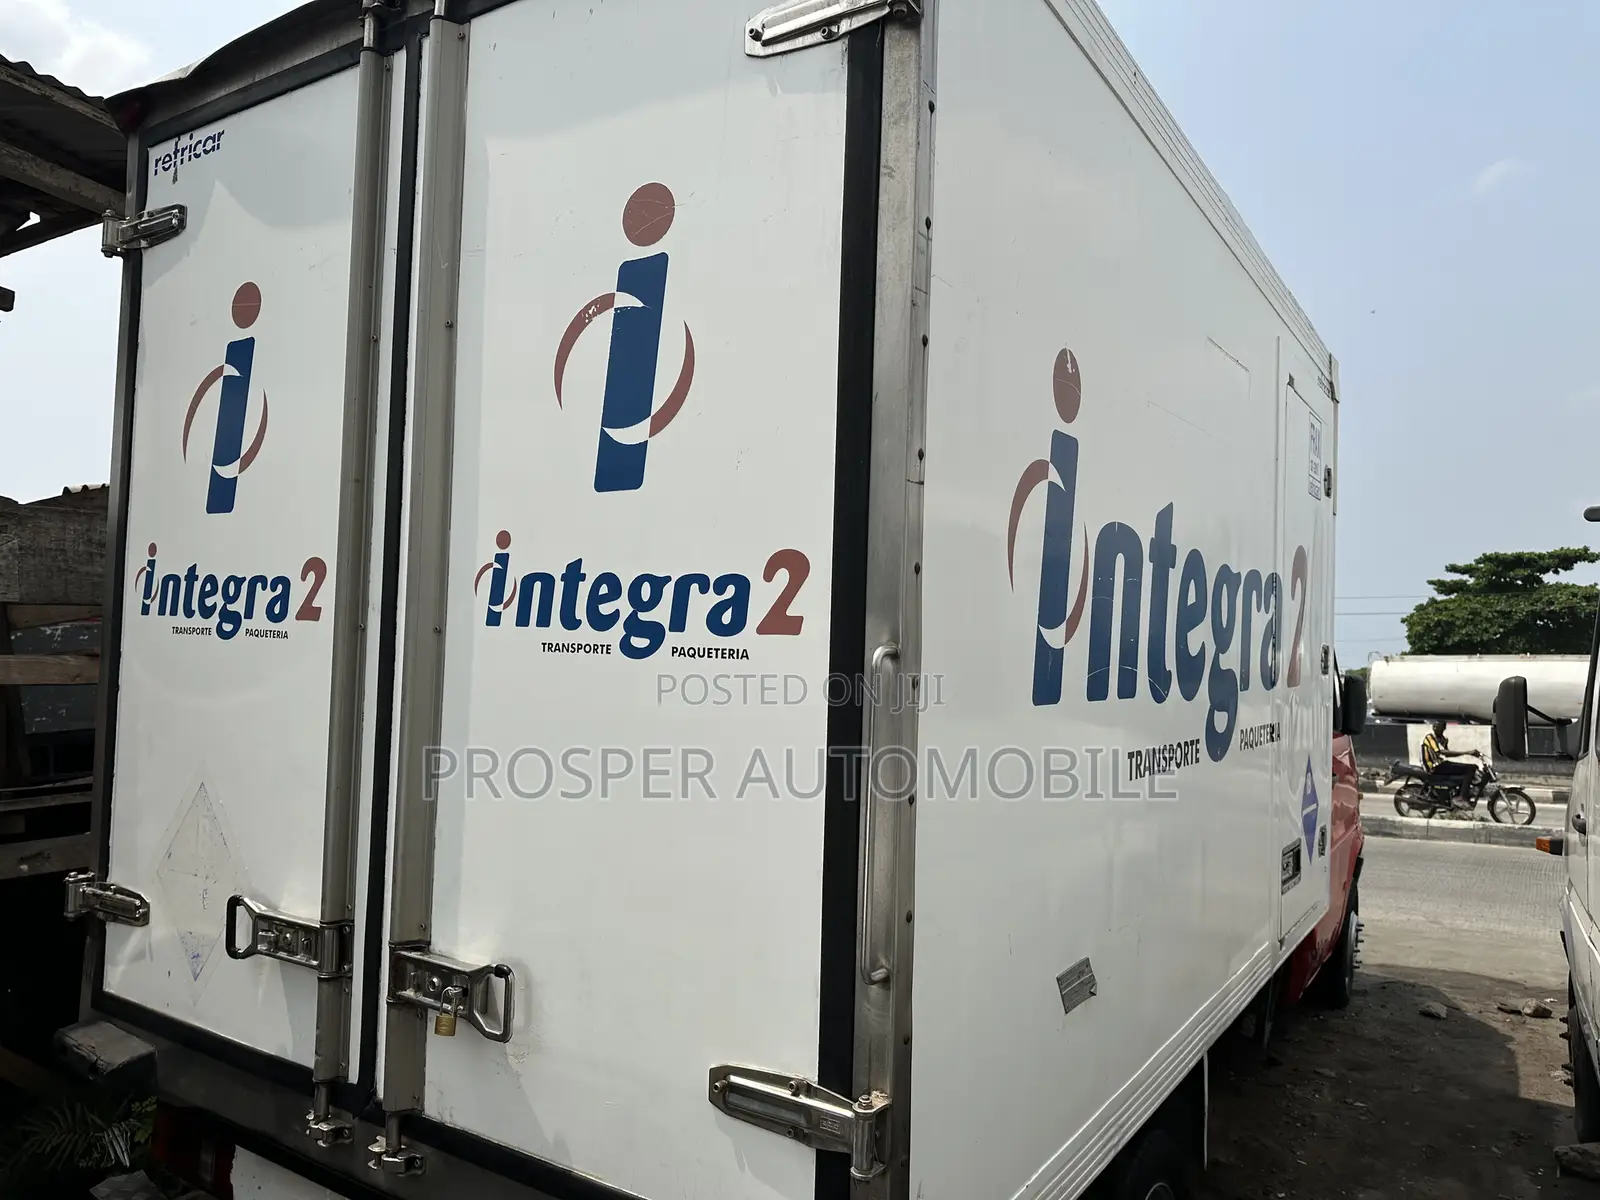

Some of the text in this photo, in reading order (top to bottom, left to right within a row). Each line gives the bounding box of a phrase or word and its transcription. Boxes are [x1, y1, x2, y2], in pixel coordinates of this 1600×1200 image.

[154, 129, 225, 184] refricar
[172, 626, 289, 640] TRANSPORTE PAQUETERIA
[541, 642, 750, 660] TRANSPORTE PAQUETERIA
[1127, 722, 1281, 781] TRANSPORTE PAQUETERIA
